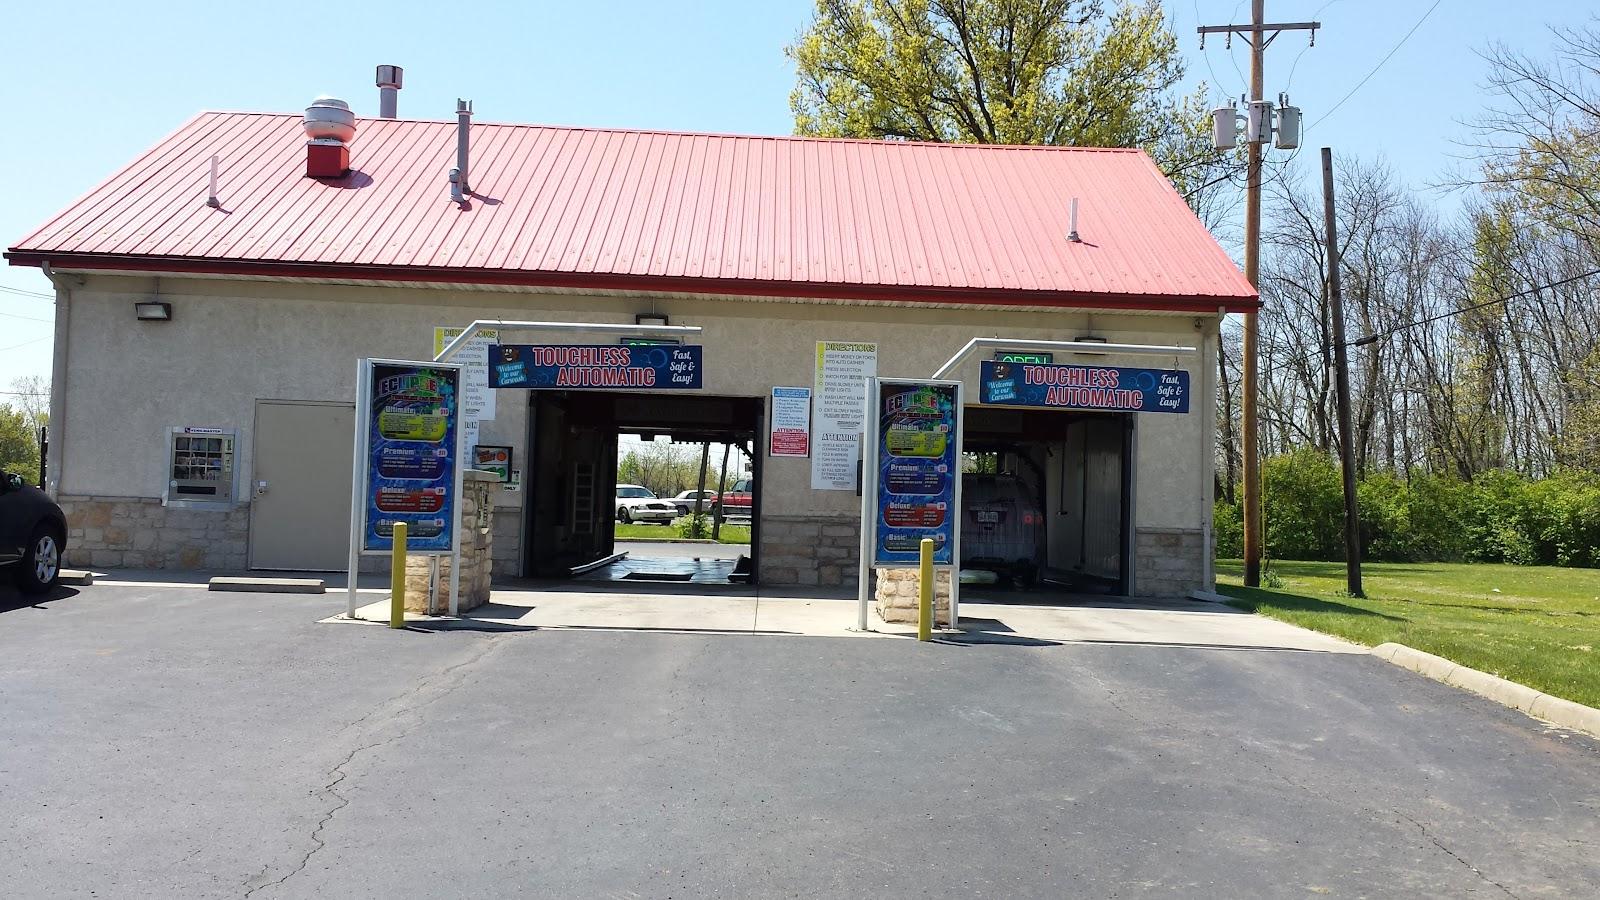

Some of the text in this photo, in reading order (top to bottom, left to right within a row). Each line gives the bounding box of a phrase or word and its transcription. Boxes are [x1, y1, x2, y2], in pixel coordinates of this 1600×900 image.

[825, 342, 876, 352] DIRECTIONS
[533, 347, 631, 367] TOUCHLESS
[673, 350, 692, 360] Fast,
[499, 364, 523, 373] Welcome
[670, 362, 695, 373] Safe &
[503, 370, 509, 378] to
[556, 366, 656, 387] AUTOMATIC
[672, 373, 693, 385] Easy!
[1023, 365, 1119, 388] TOUCHLESS
[1161, 374, 1180, 385] Fast,
[379, 374, 438, 397] ECLIPSE
[500, 375, 525, 385] Carwash
[1157, 385, 1183, 397] Safe &
[886, 391, 938, 415] ECLIPSE
[1045, 386, 1143, 409] AUTOMATIC
[1159, 396, 1180, 409] Easy!
[385, 406, 415, 414] Ultimate
[891, 423, 917, 431] Ultimate
[821, 432, 858, 442] ATTENTION
[383, 447, 415, 455] Premium
